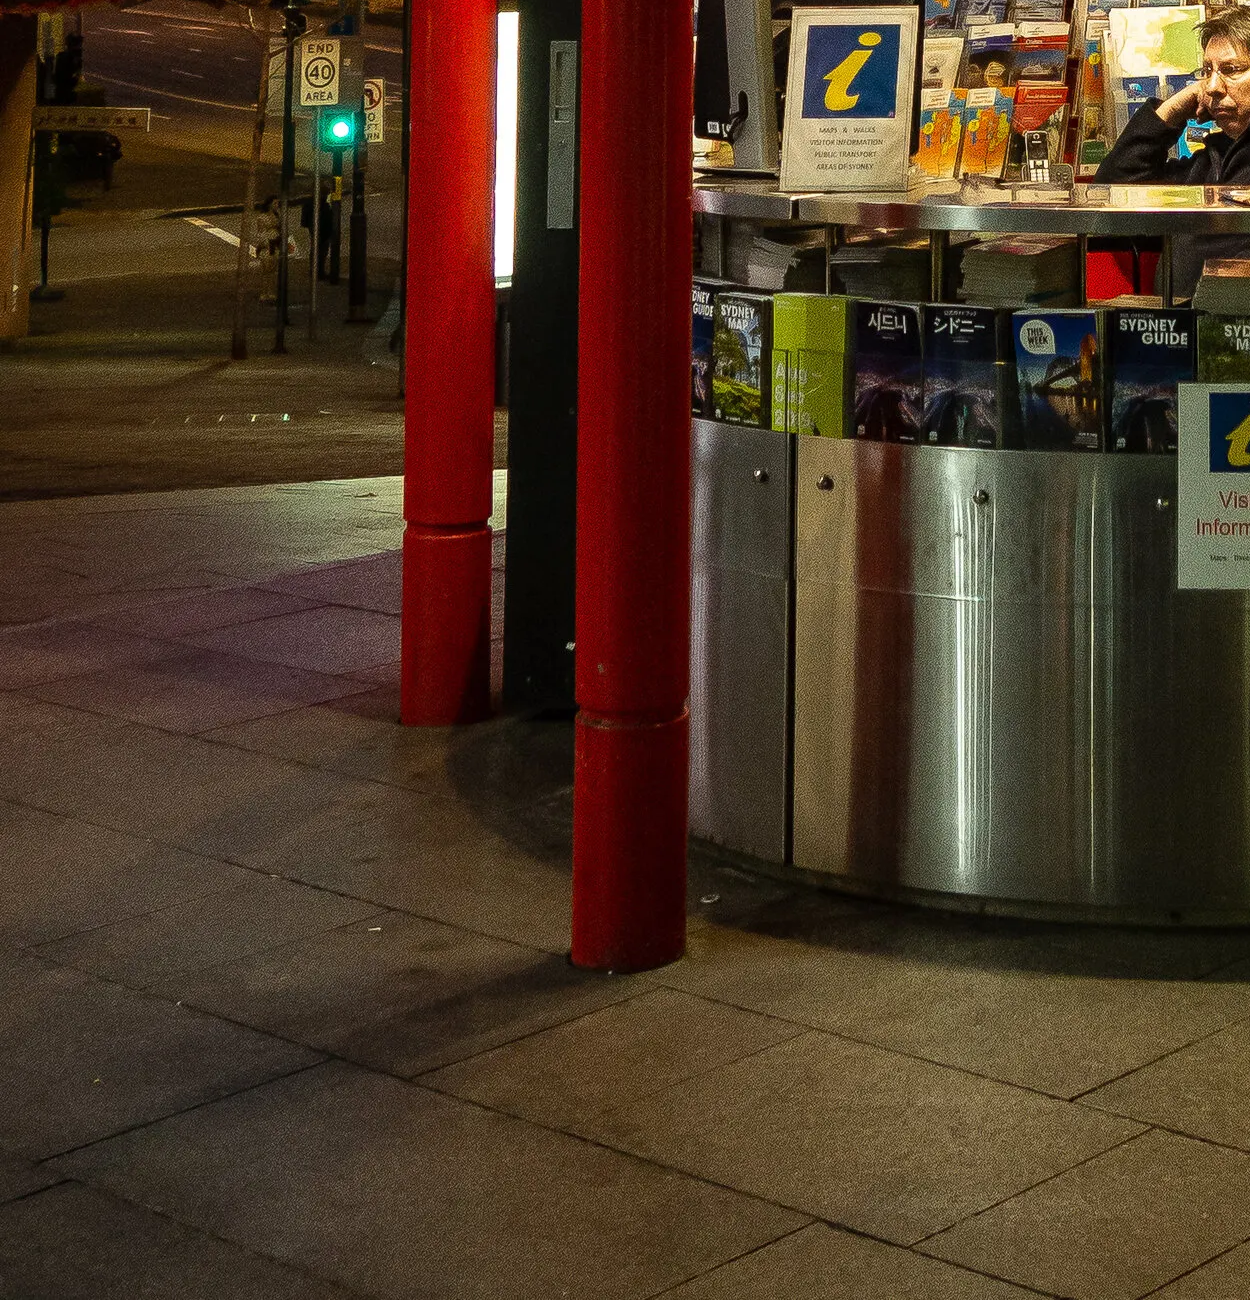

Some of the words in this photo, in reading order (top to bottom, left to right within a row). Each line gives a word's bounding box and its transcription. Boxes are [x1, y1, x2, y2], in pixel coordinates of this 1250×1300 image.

[308, 44, 334, 54] END
[310, 65, 332, 80] 40
[305, 91, 334, 102] AREA
[816, 163, 837, 171] AREAS
[848, 163, 875, 171] SYDNEY
[692, 291, 710, 303] DNEY
[693, 305, 714, 318] GUIDE
[721, 304, 755, 319] SYDNEY
[728, 317, 749, 330] MAP
[868, 313, 907, 334] 시드니
[934, 317, 986, 335] シドニー
[1120, 319, 1177, 332] SYDNEY
[1027, 327, 1044, 337] THIS
[1028, 335, 1049, 345] WEEK
[1142, 332, 1188, 346] GUIDE
[1209, 555, 1227, 563] Maps
